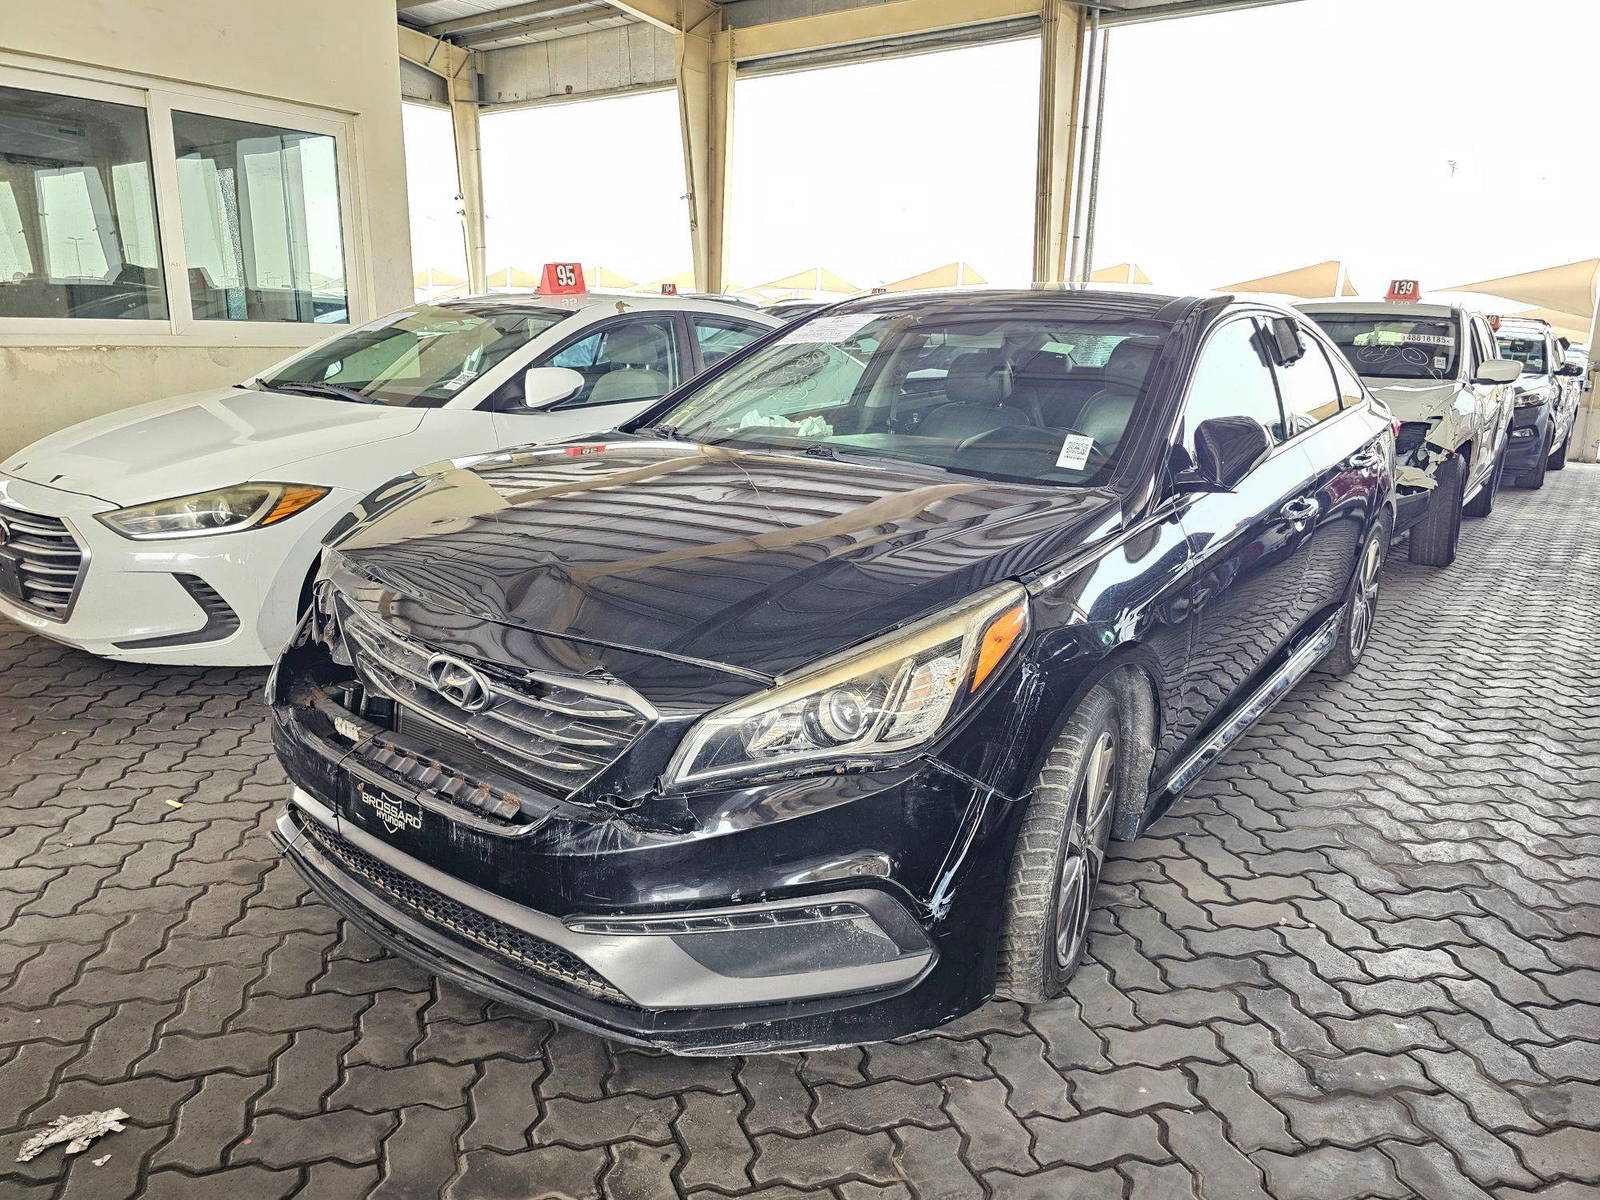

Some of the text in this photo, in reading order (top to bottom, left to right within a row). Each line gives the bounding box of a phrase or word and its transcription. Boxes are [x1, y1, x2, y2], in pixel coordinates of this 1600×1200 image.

[556, 264, 576, 286] 95
[1393, 280, 1414, 295] 139
[362, 791, 422, 829] BROSSARD
[376, 809, 406, 831] HYUNDAI
